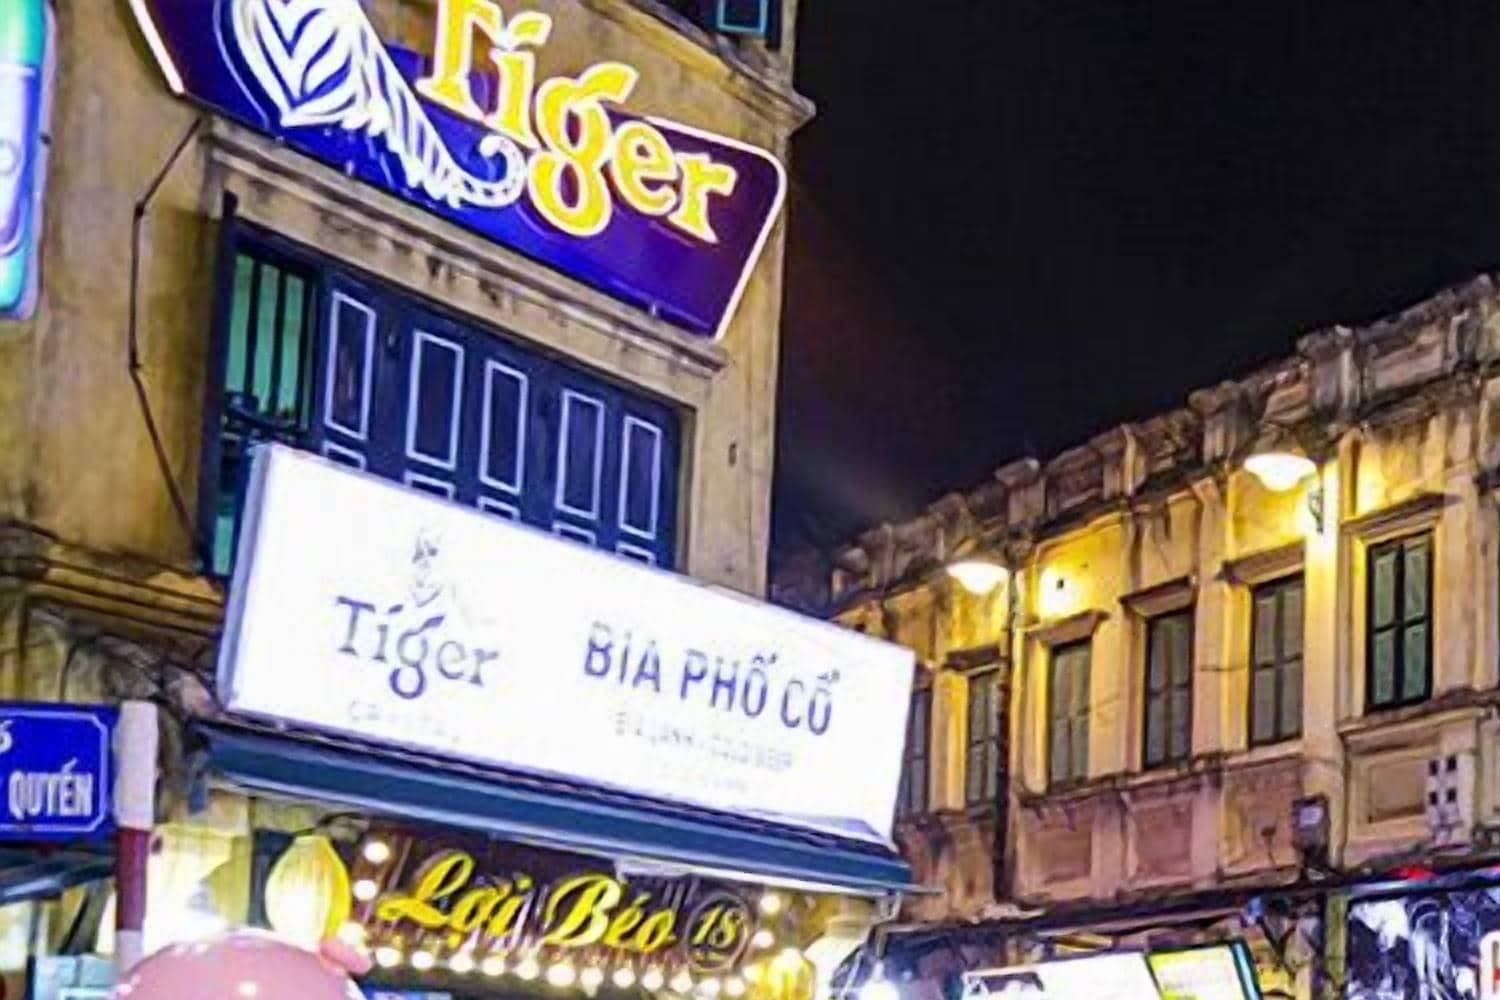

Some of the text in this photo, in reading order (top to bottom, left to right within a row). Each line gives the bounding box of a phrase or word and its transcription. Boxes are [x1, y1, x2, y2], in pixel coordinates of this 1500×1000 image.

[415, 0, 738, 243] Tiger
[335, 595, 499, 699] Tiger
[583, 620, 661, 693] BIA
[543, 874, 678, 953] Béo
[693, 907, 744, 947] 18
